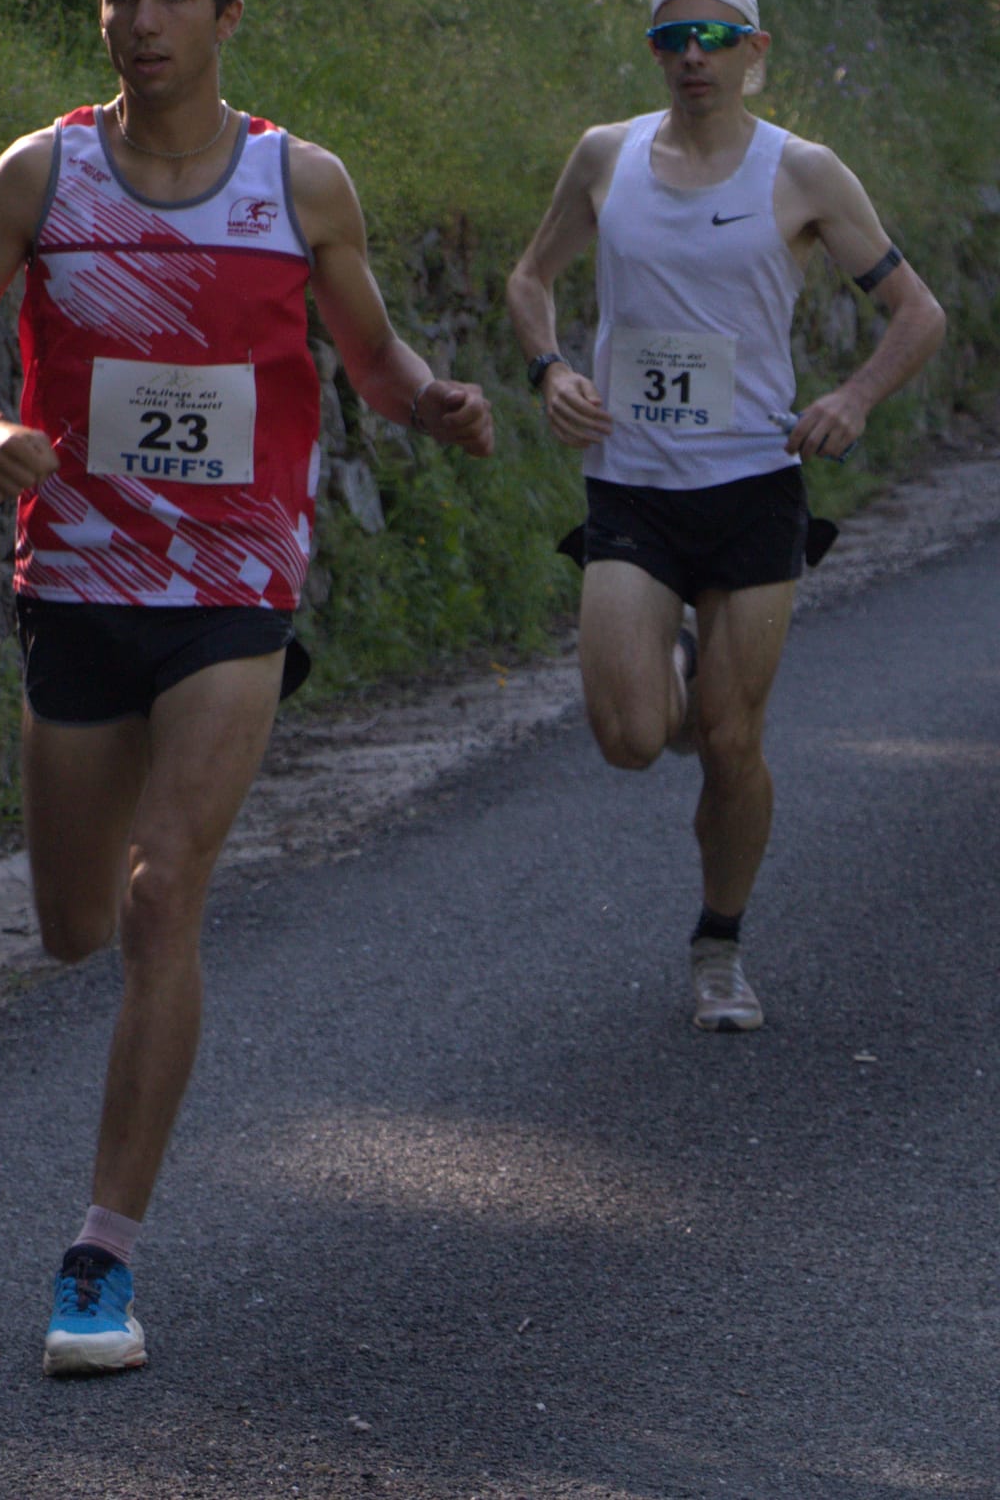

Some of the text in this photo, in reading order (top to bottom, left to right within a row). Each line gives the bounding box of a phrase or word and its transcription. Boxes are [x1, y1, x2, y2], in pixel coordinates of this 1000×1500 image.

[136, 386, 192, 400] Challenge
[644, 369, 691, 404] 31
[631, 404, 709, 425] TUFF'S
[138, 411, 209, 453] 23
[120, 452, 224, 479] TUFF'S
